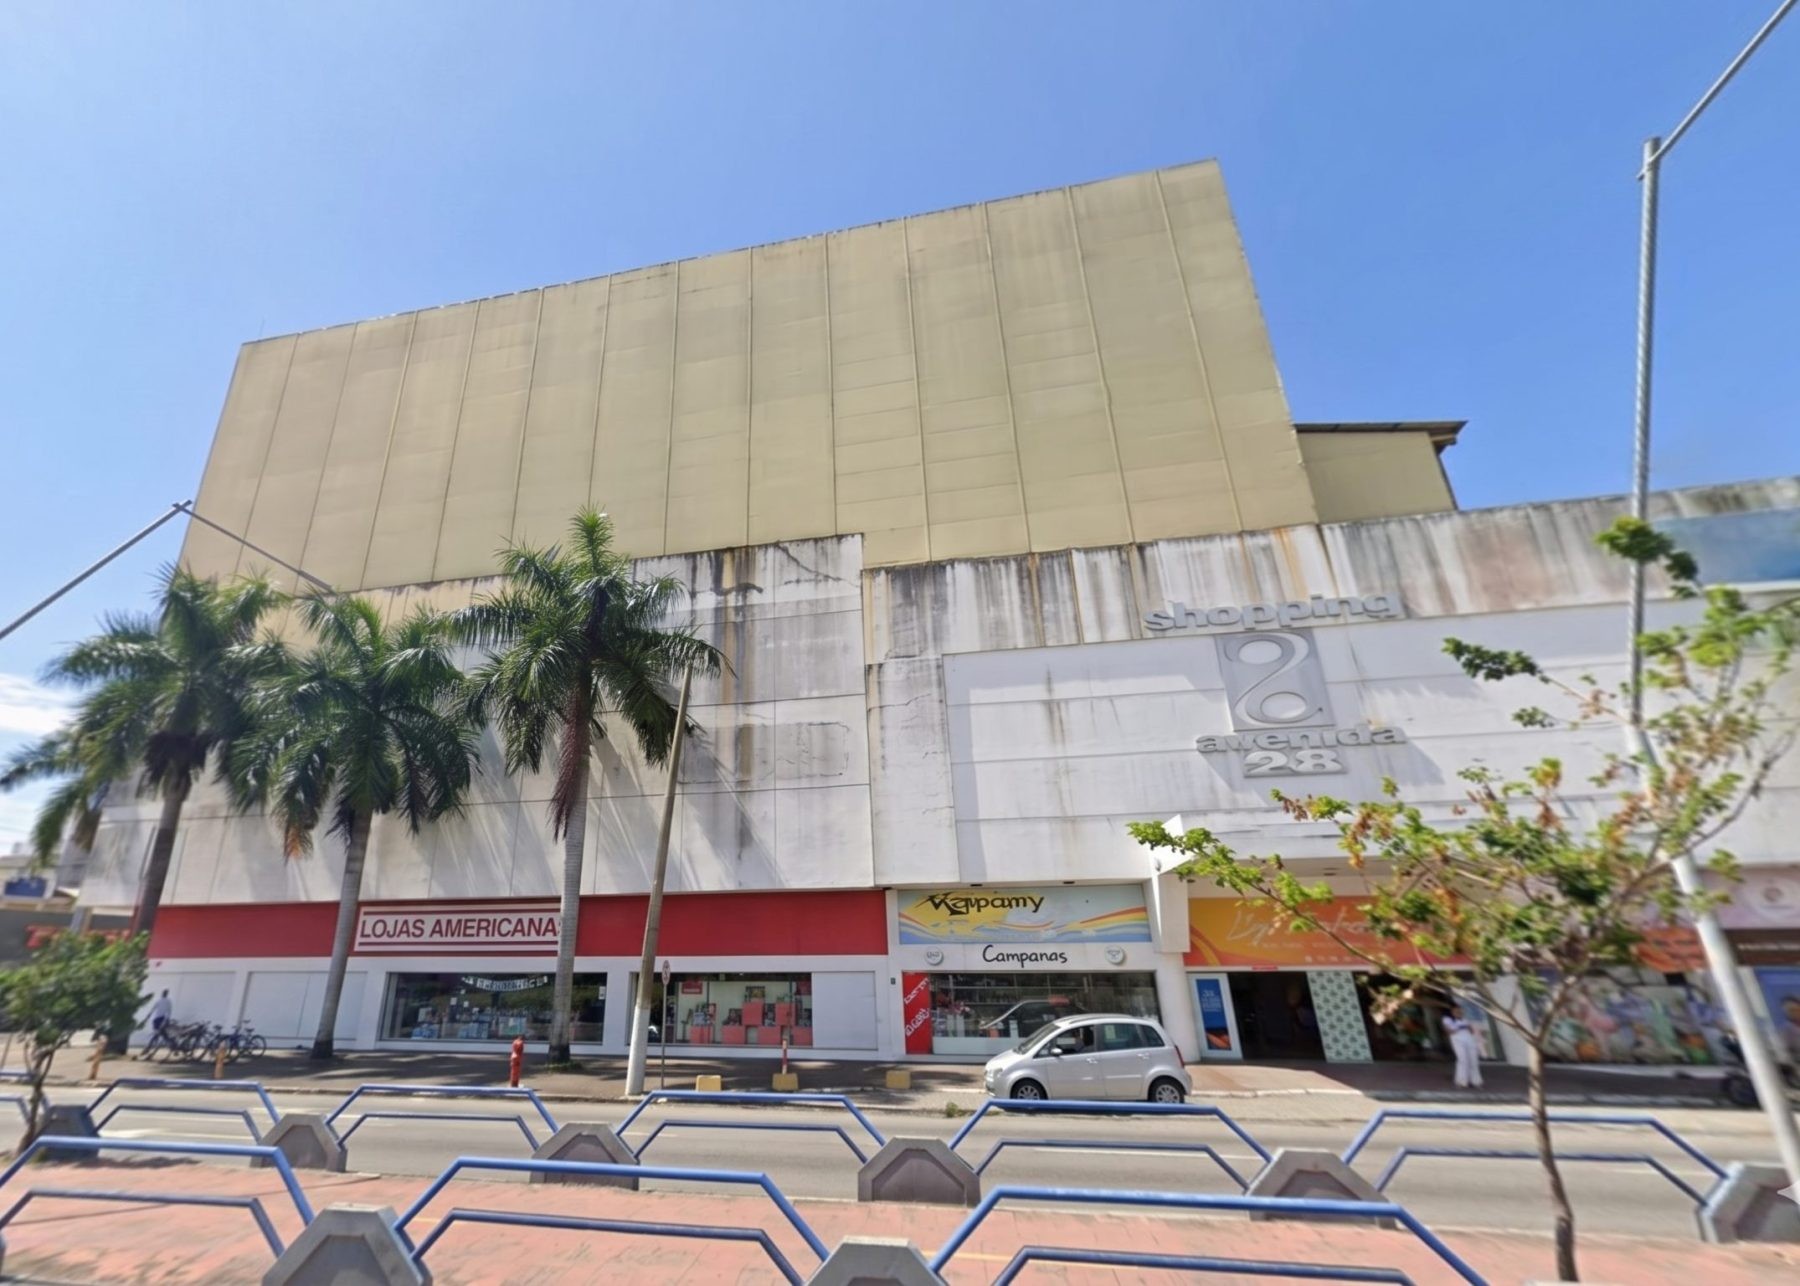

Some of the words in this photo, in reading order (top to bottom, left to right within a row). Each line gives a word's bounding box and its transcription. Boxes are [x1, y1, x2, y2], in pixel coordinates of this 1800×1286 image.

[1145, 595, 1402, 630] shopping
[1197, 724, 1407, 753] avenida
[1244, 750, 1344, 776] 28
[360, 918, 424, 938] LOJAS
[429, 917, 561, 938] AMERICANA
[983, 944, 1068, 968] Campanas
